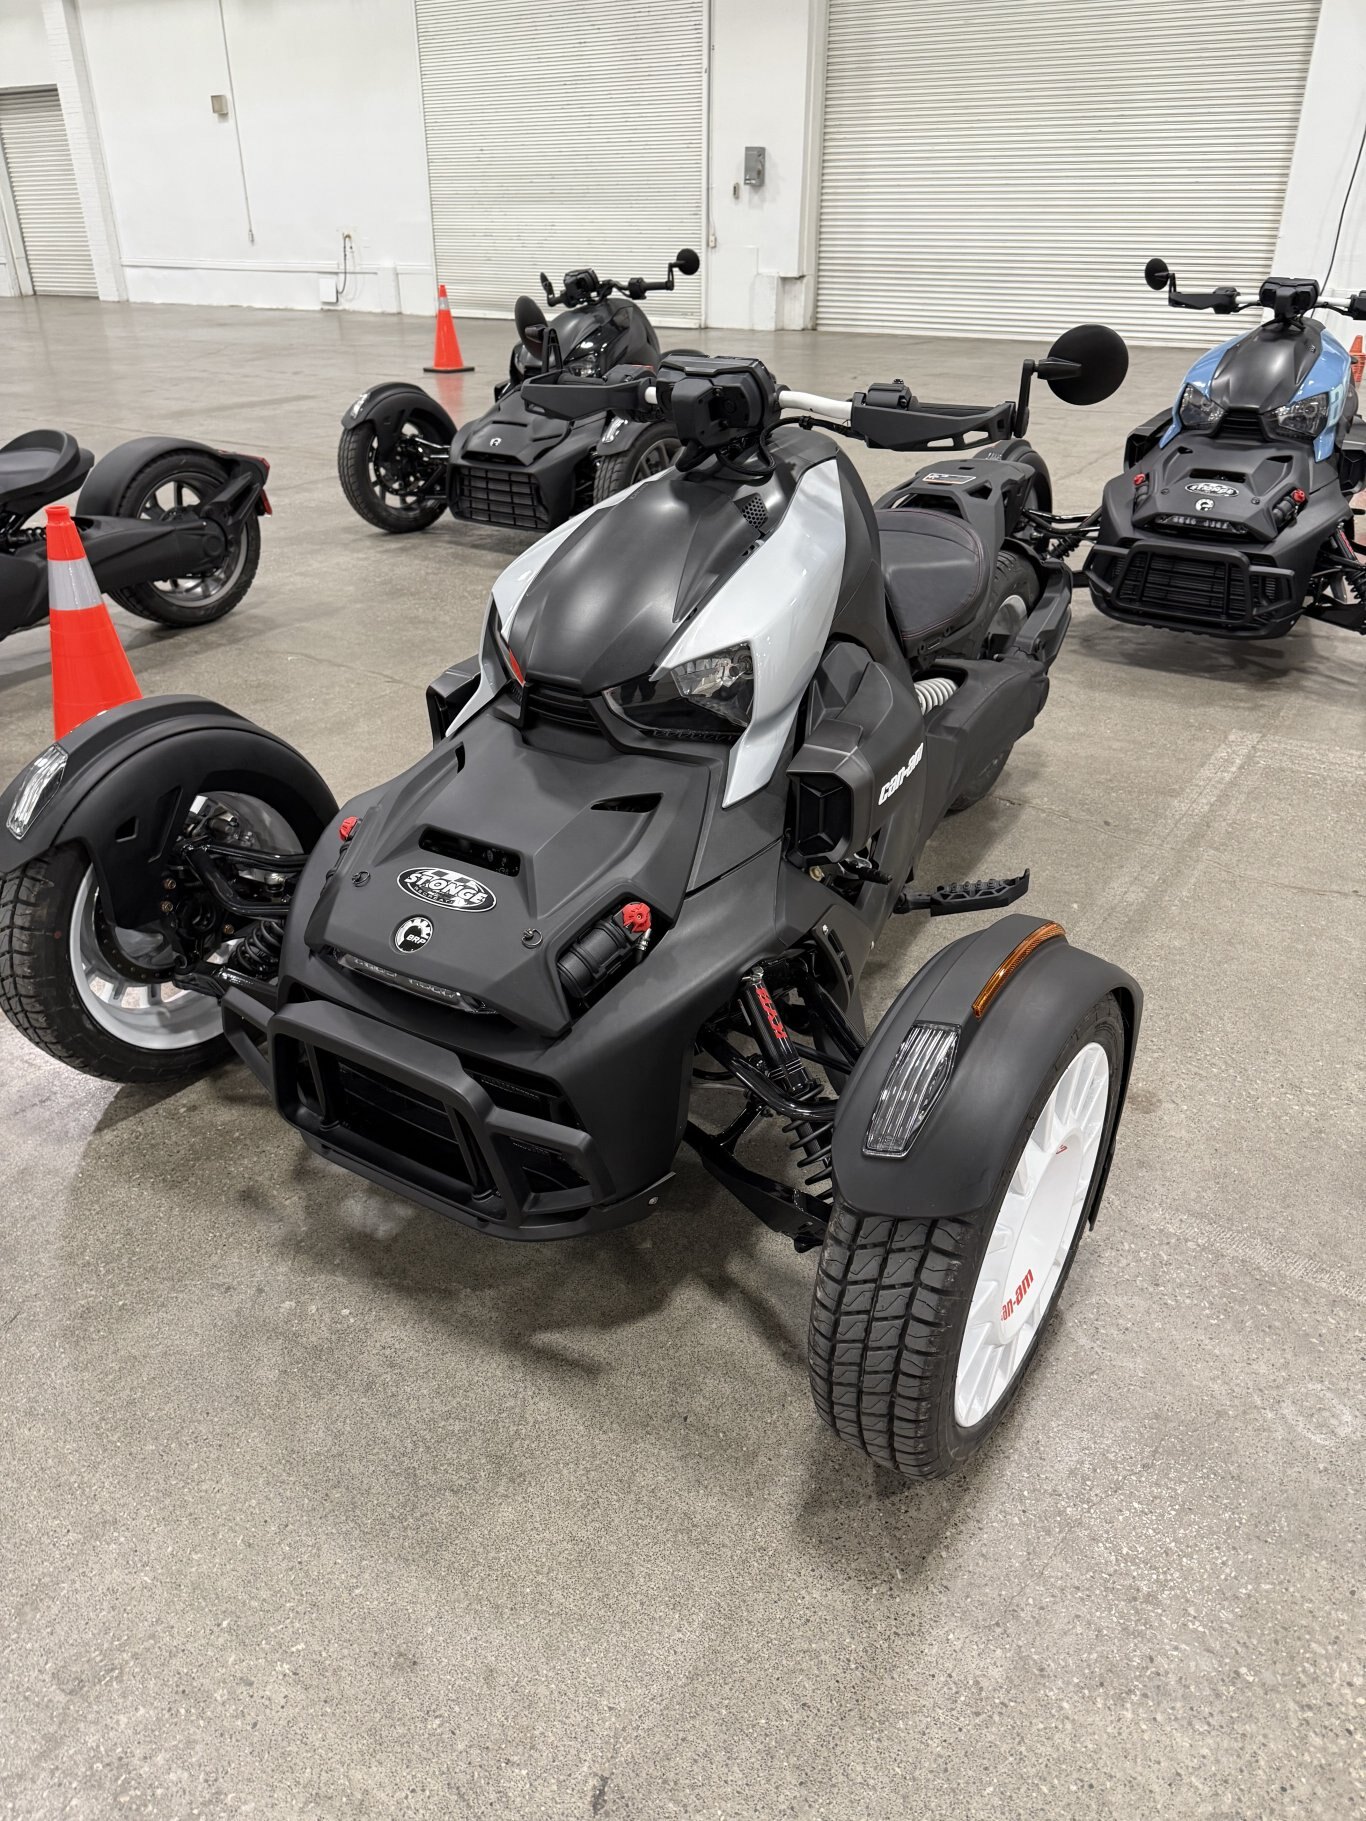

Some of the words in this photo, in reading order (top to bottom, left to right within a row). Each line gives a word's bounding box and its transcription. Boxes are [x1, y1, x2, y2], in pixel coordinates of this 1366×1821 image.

[878, 742, 924, 806] can-am
[406, 934, 427, 945] BRP
[1000, 1268, 1034, 1322] an-am
